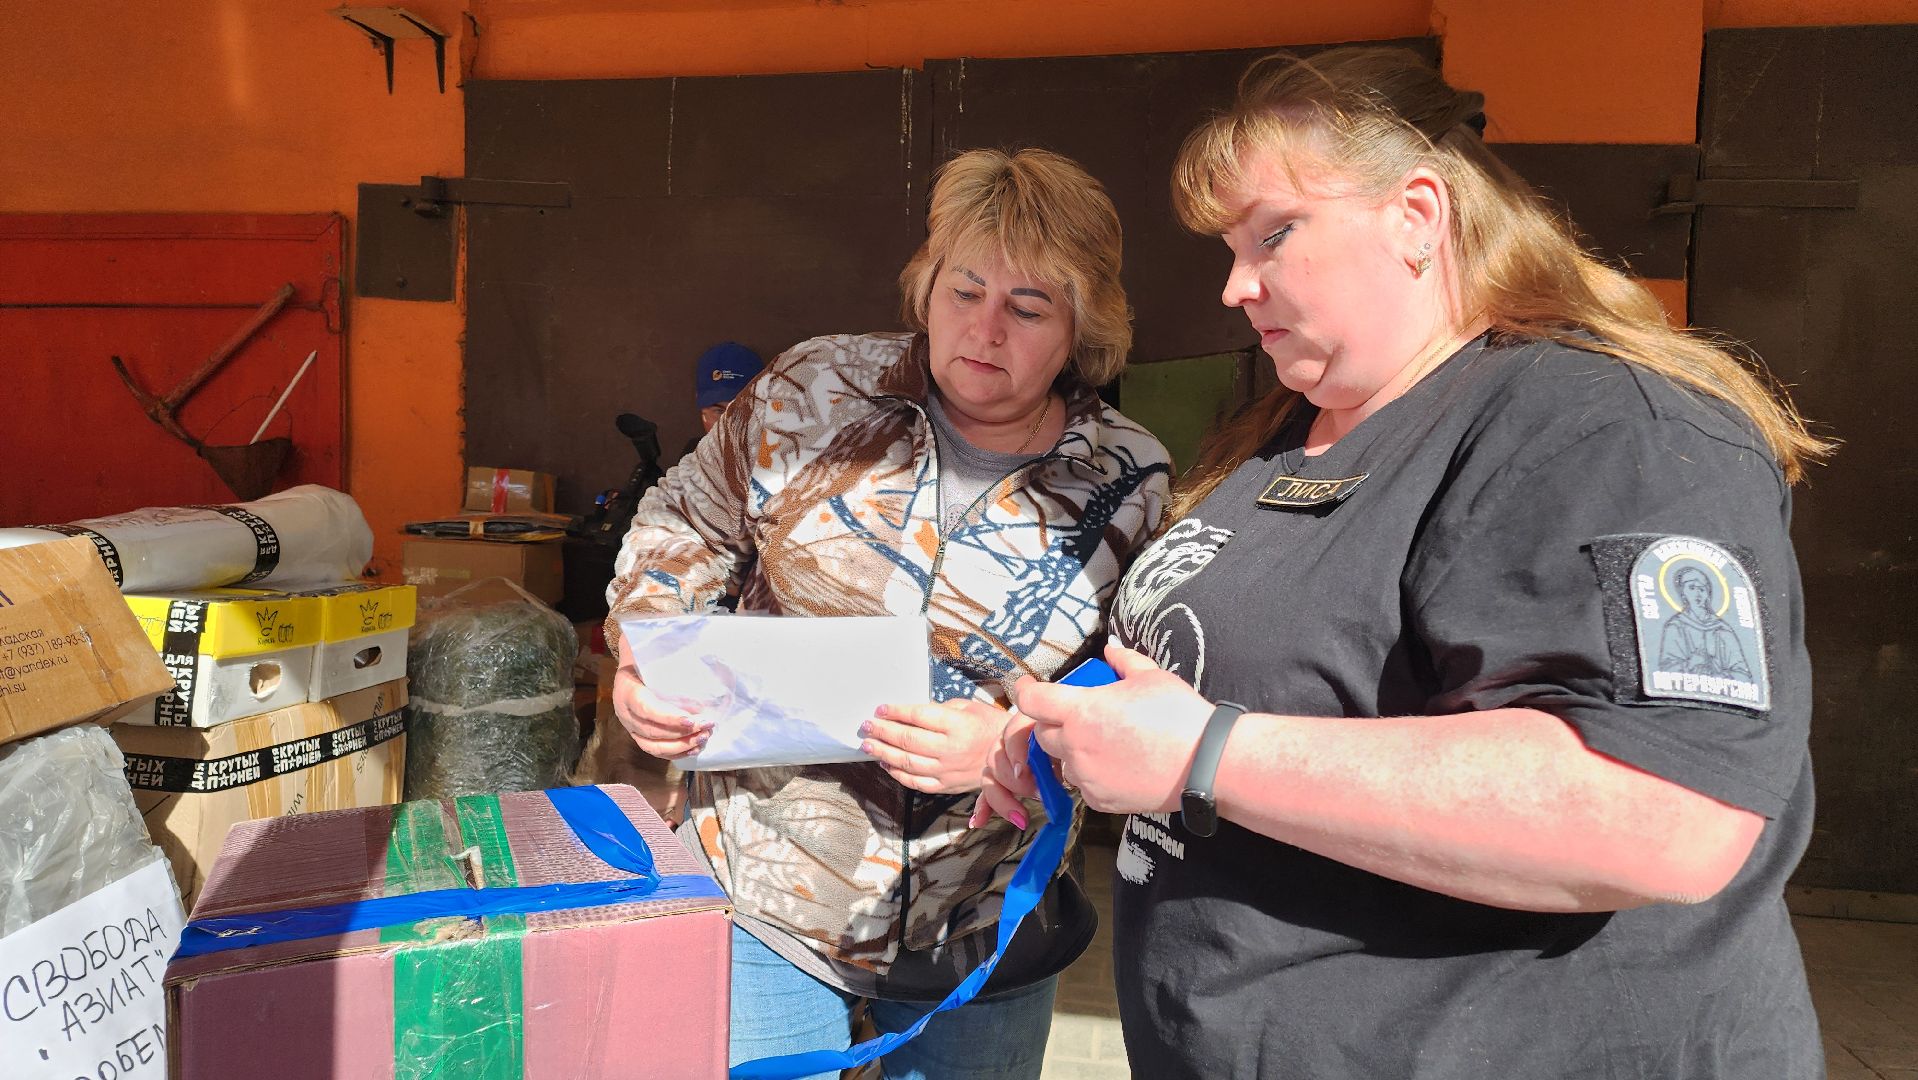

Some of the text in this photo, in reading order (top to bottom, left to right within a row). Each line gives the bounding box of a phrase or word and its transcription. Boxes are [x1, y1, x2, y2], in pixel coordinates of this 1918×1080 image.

[174, 668, 193, 727] КРУТЫ
[208, 752, 260, 776] КРУТЫХ
[280, 738, 320, 759] КРУТЫХ
[3, 908, 167, 1021] СВОБОДА
